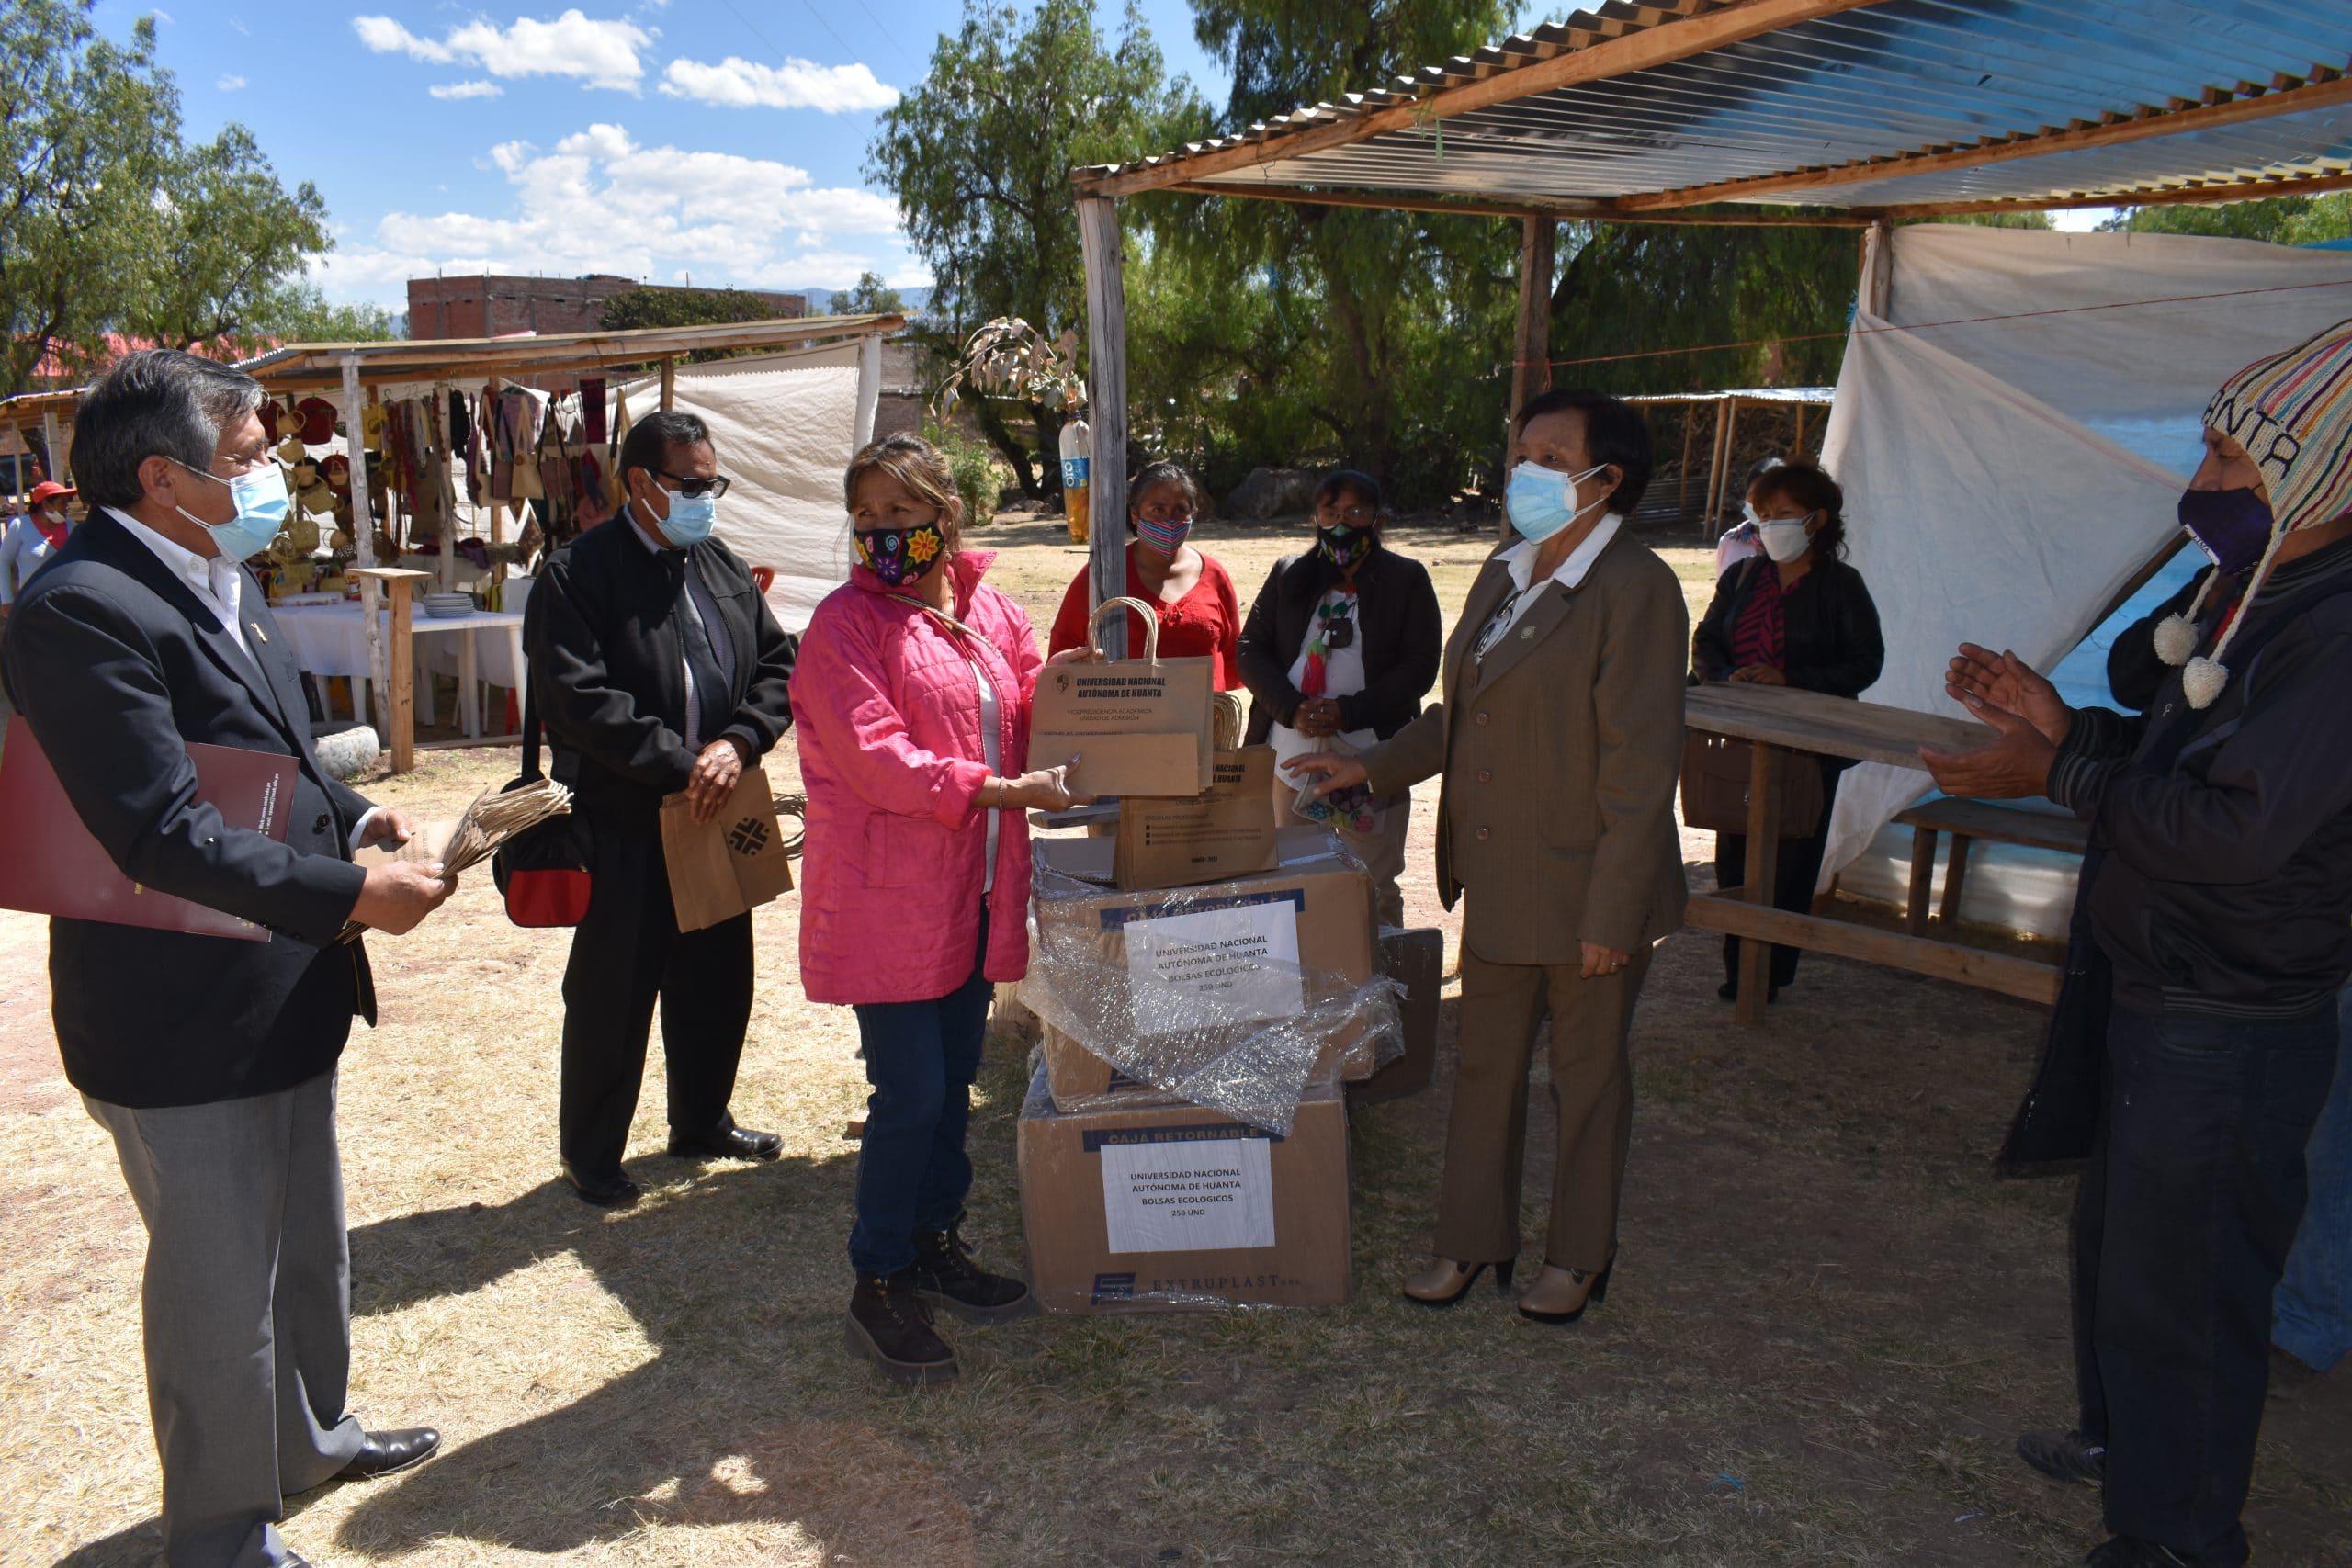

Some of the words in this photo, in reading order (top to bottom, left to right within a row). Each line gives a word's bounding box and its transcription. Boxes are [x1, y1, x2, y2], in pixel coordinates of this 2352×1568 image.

[1076, 677, 1126, 687] UNIVERSIDAD
[1128, 677, 1166, 687] NACIONAL
[1078, 688, 1119, 698] AUTÓNOMA
[1121, 689, 1131, 698] DE
[1132, 689, 1162, 698] HUANTA
[1215, 764, 1245, 773] NACIONAL
[1155, 942, 1217, 958] UNIVERSIDAD
[1219, 935, 1268, 949] NACIONAL
[1158, 954, 1213, 970] AUTÓNOMA
[1215, 953, 1229, 963] DE
[1229, 947, 1269, 960] HUANTA
[1168, 971, 1203, 983] BOLSAS
[1108, 1133, 1148, 1145] CAJA
[1154, 1128, 1259, 1142] RETORNABLE
[1130, 1170, 1192, 1181] UNIVERSIDAD
[1193, 1168, 1241, 1179] NACIONAL
[1132, 1182, 1187, 1193] AUTÓNOMA
[1188, 1182, 1201, 1190] DE
[1202, 1180, 1242, 1190] HUANTA
[1141, 1197, 1176, 1206] BOLSAS
[1177, 1193, 1234, 1204] ECOLOGICOS
[1188, 1208, 1206, 1216] UND
[1153, 1274, 1280, 1292] EXTRUPLAST
